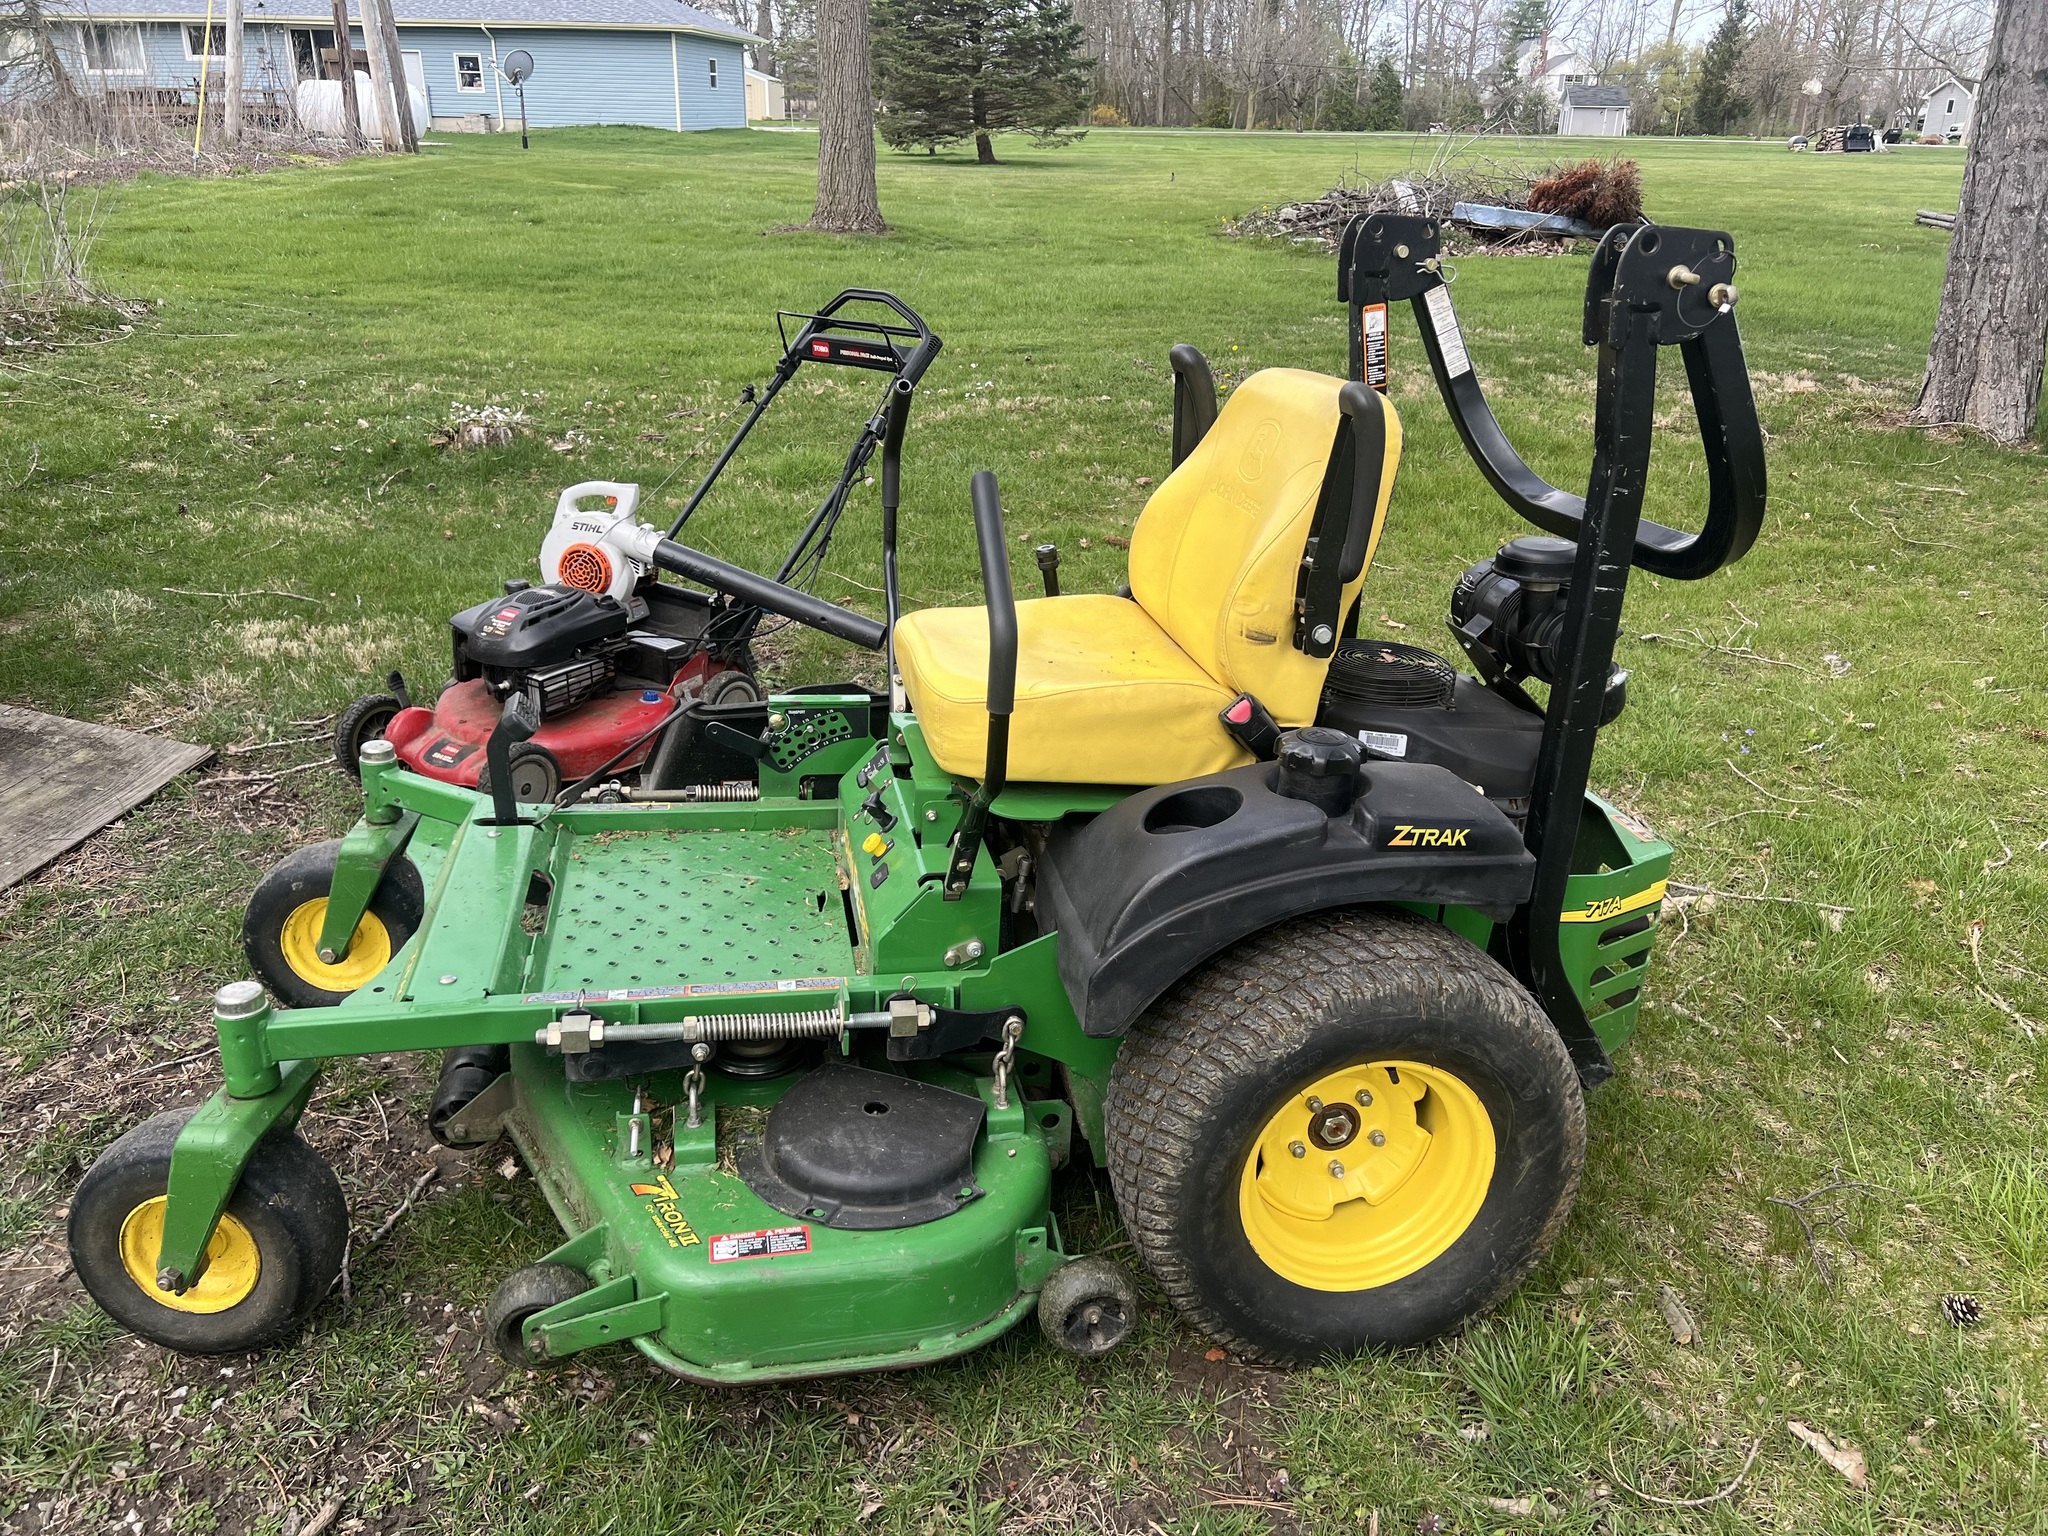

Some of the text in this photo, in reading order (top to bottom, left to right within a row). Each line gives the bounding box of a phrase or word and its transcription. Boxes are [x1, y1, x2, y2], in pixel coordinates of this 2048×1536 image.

[813, 344, 829, 353] TORO
[1209, 480, 1262, 519] JOHN DEERE
[572, 521, 603, 534] STIHL
[1387, 825, 1471, 846] ZTRAK
[1586, 895, 1622, 918] 717A
[729, 1231, 757, 1240] DANGER
[774, 1226, 802, 1235] PELIGRO
